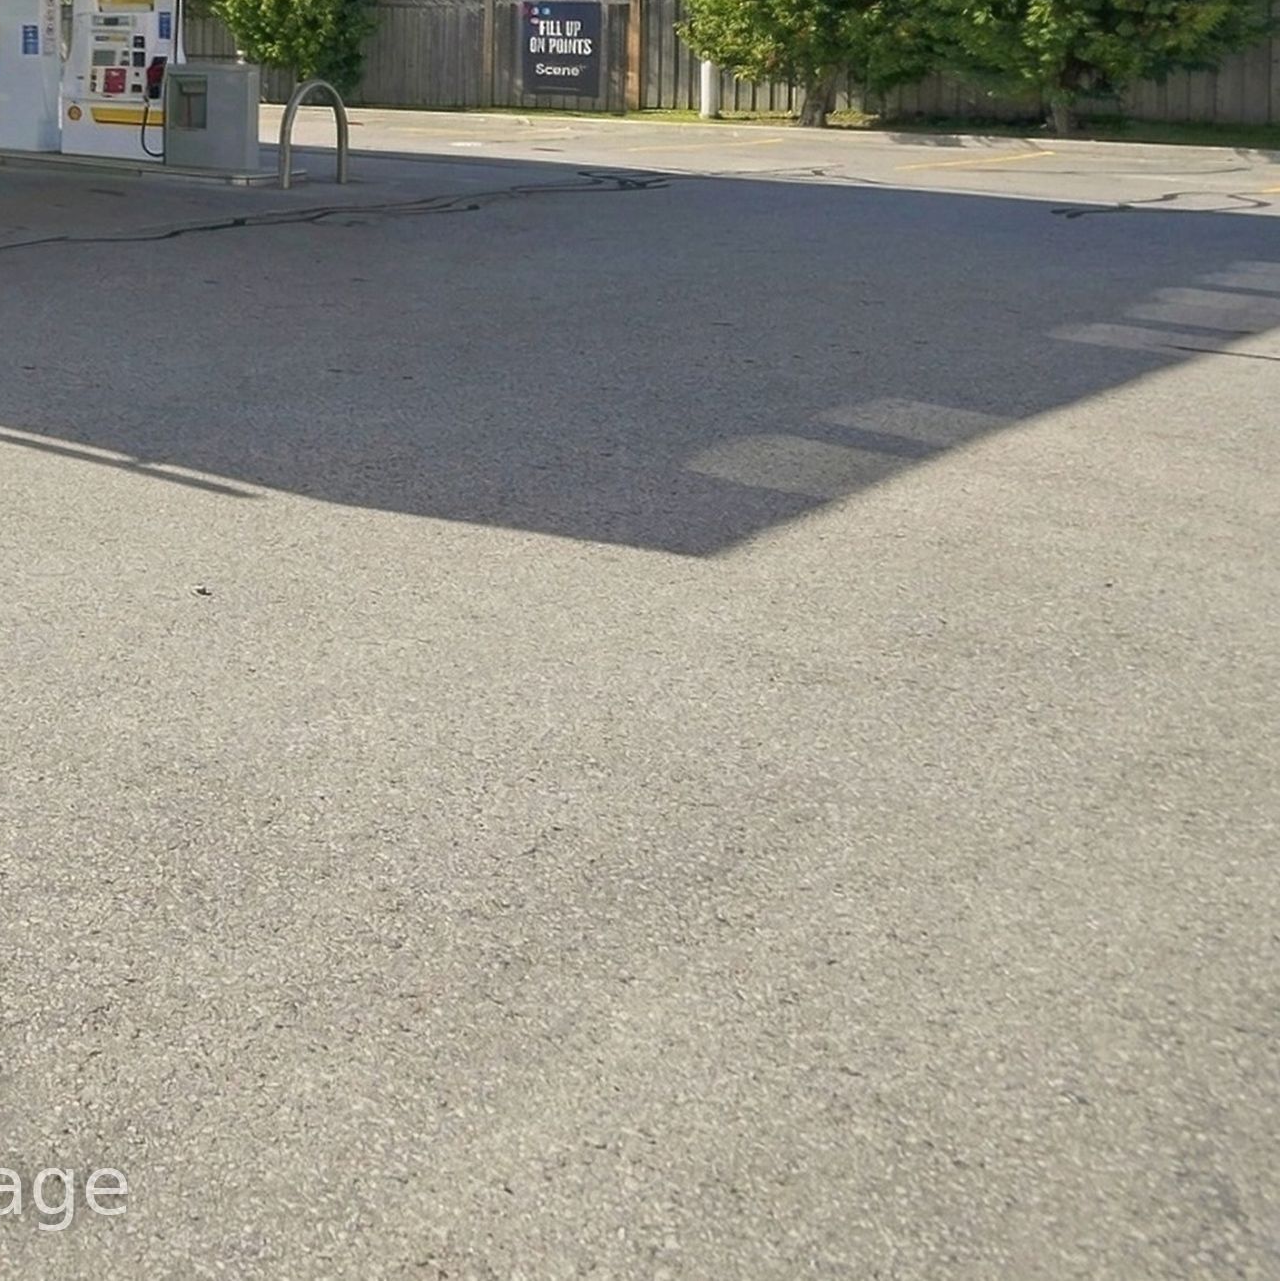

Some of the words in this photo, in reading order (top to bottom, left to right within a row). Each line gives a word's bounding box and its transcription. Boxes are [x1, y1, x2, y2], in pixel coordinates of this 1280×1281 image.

[539, 20, 563, 37] FILL
[566, 20, 582, 37] UP
[529, 37, 546, 53] ON
[549, 38, 593, 56] POINTS
